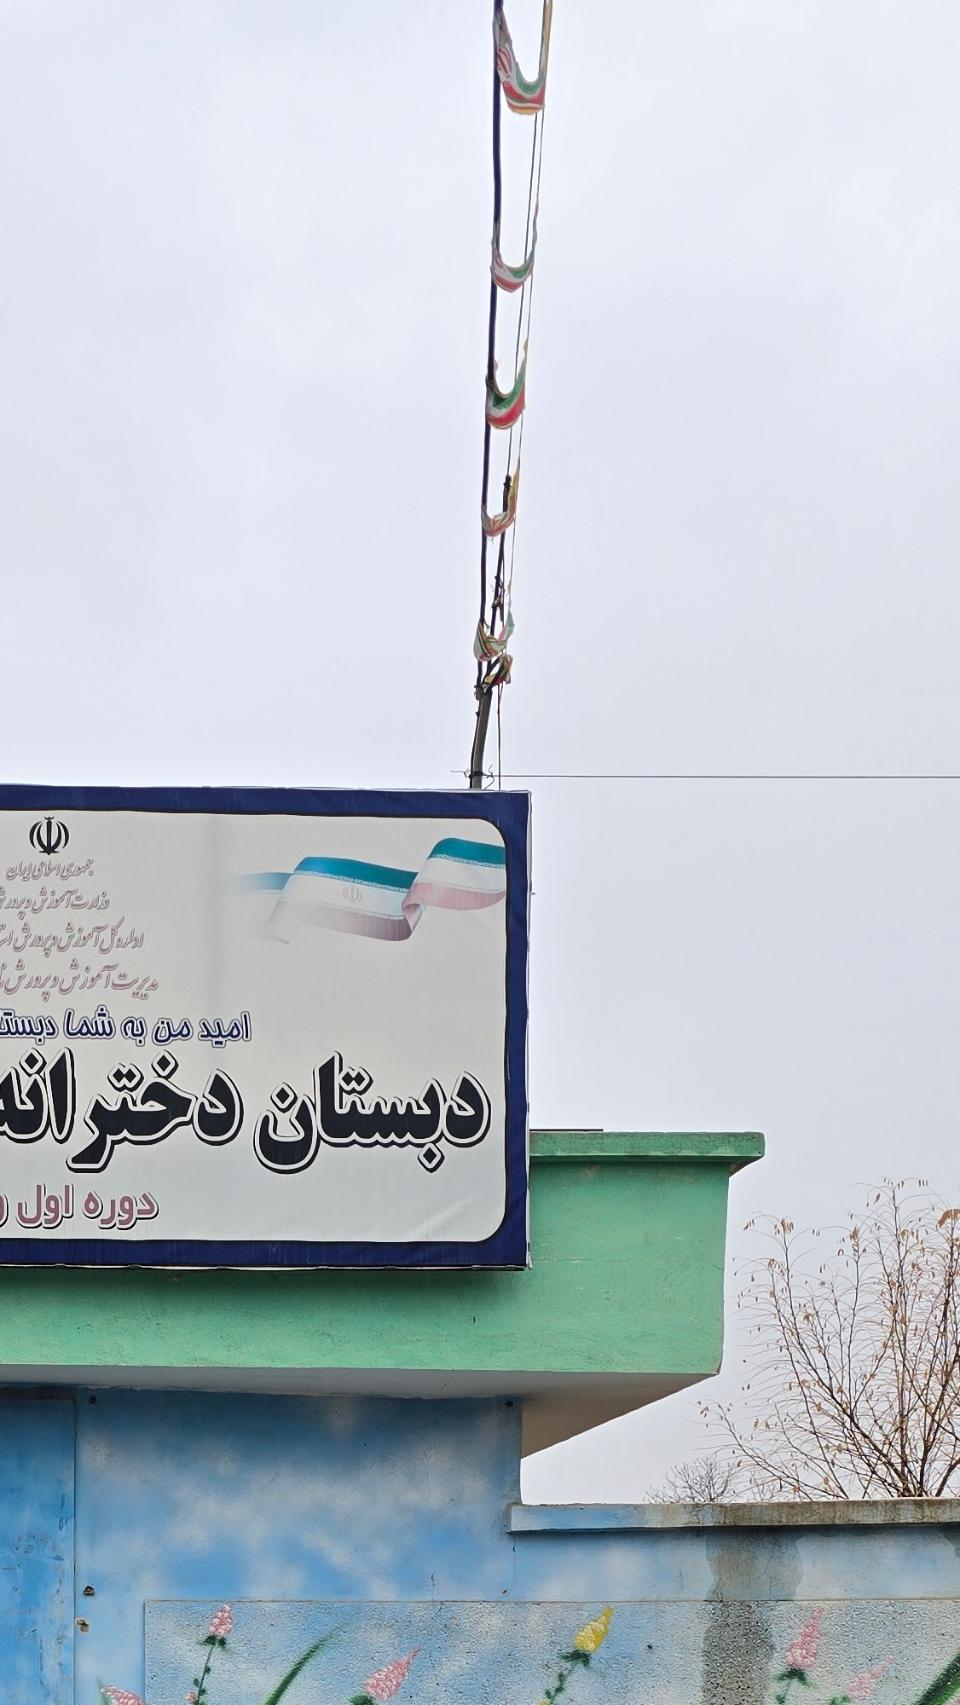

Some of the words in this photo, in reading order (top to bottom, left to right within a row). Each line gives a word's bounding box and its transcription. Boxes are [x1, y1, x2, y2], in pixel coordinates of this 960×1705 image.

[6, 860, 33, 881] ایران
[30, 859, 61, 880] اسلامی
[61, 859, 94, 880] جمهوری
[13, 922, 53, 957] پرورش
[57, 922, 108, 952] آموزش
[4, 958, 52, 1002] پرورش
[58, 958, 118, 994] آموزش
[111, 972, 159, 999] مدیریت
[63, 1005, 117, 1039] شما
[120, 1016, 146, 1047] به
[152, 1016, 193, 1044] من
[199, 1011, 251, 1048] امید
[252, 1050, 492, 1174] دبستان
[15, 1184, 75, 1228] اول
[83, 1190, 159, 1230] دوره
